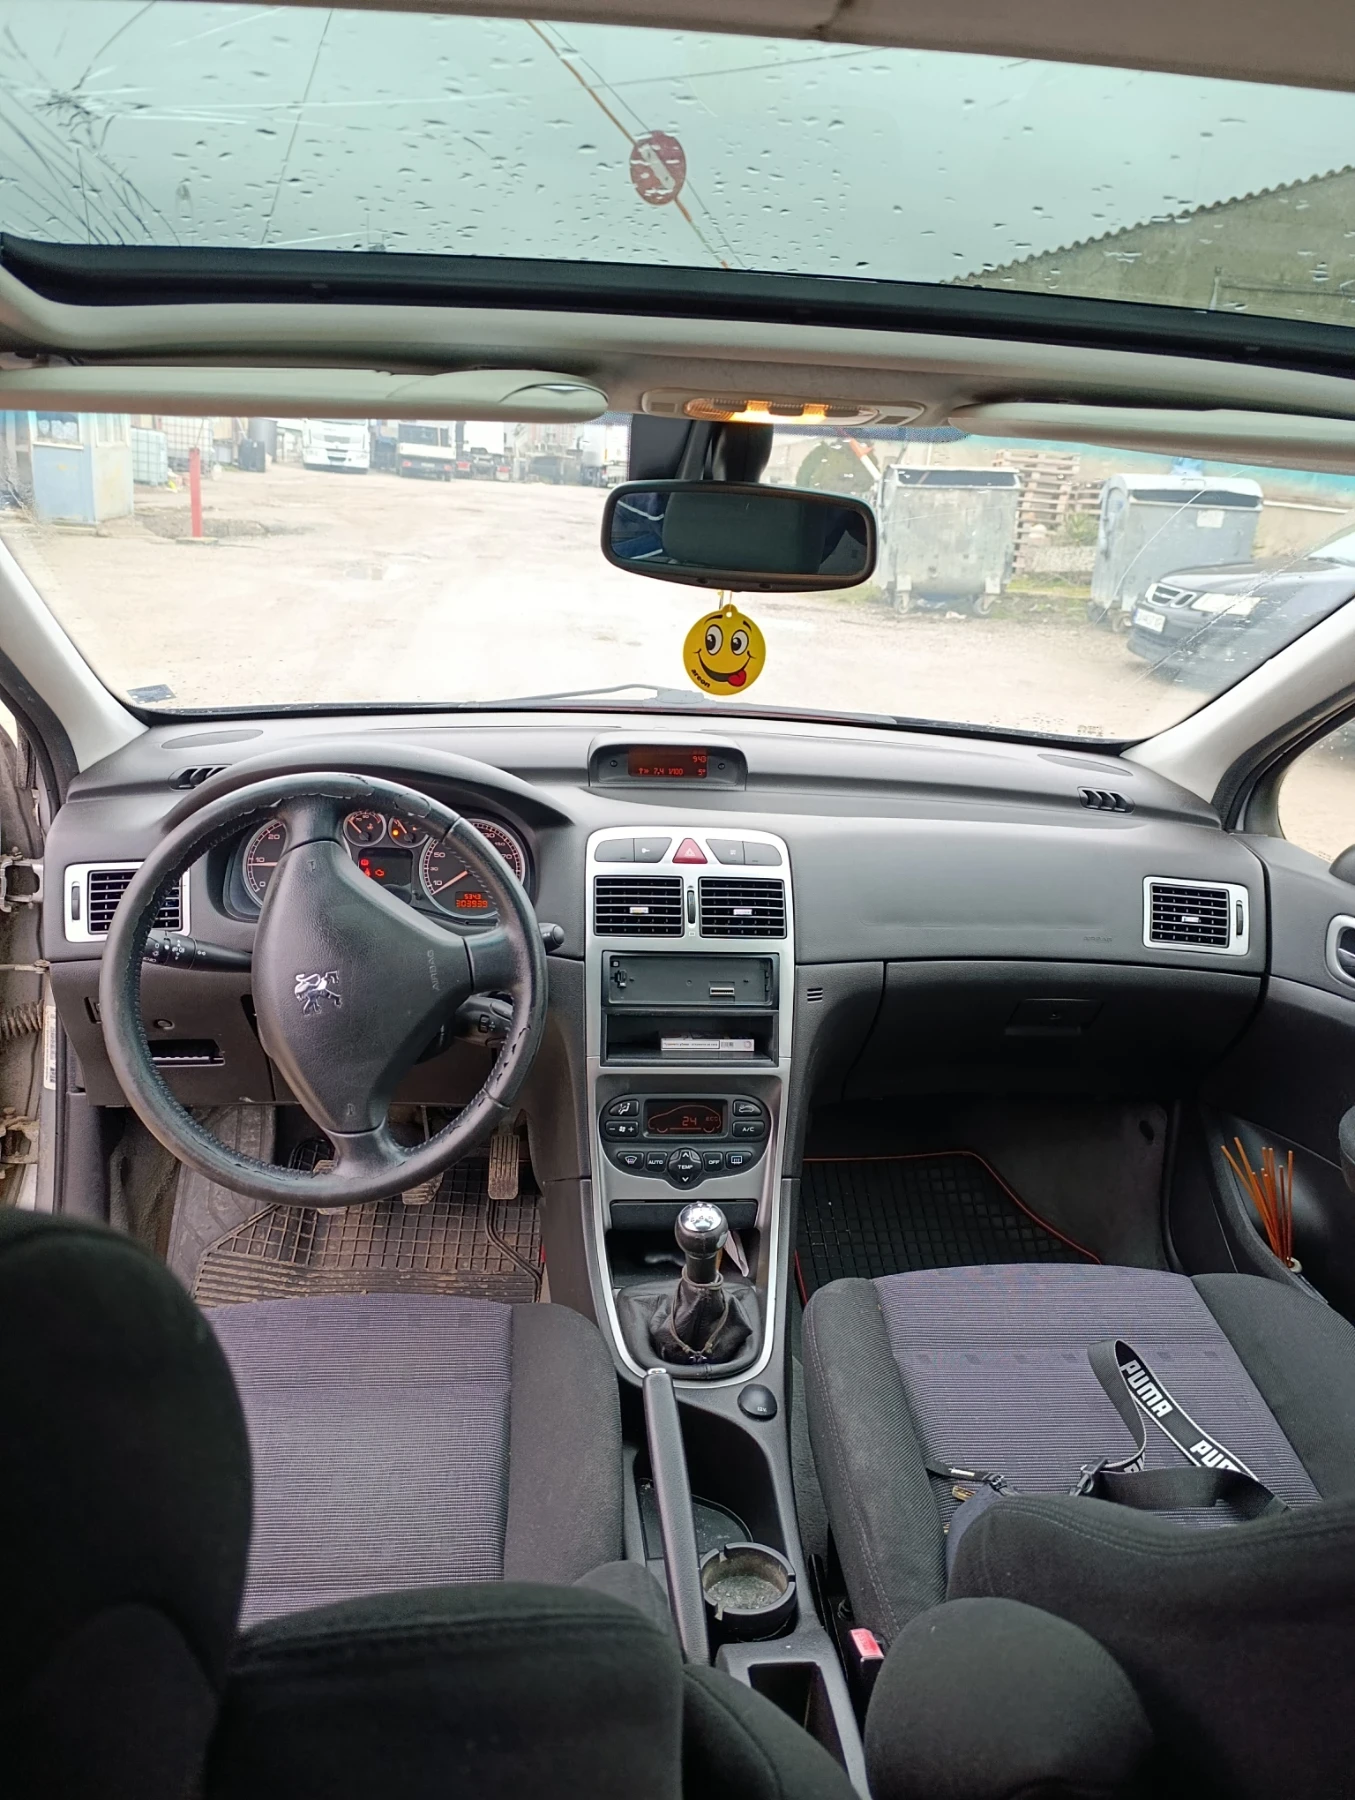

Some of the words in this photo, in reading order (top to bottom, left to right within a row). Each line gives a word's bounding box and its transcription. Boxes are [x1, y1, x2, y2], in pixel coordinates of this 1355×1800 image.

[691, 668, 711, 688] areon
[682, 1116, 697, 1126] 24
[1119, 1359, 1173, 1418] PUMA
